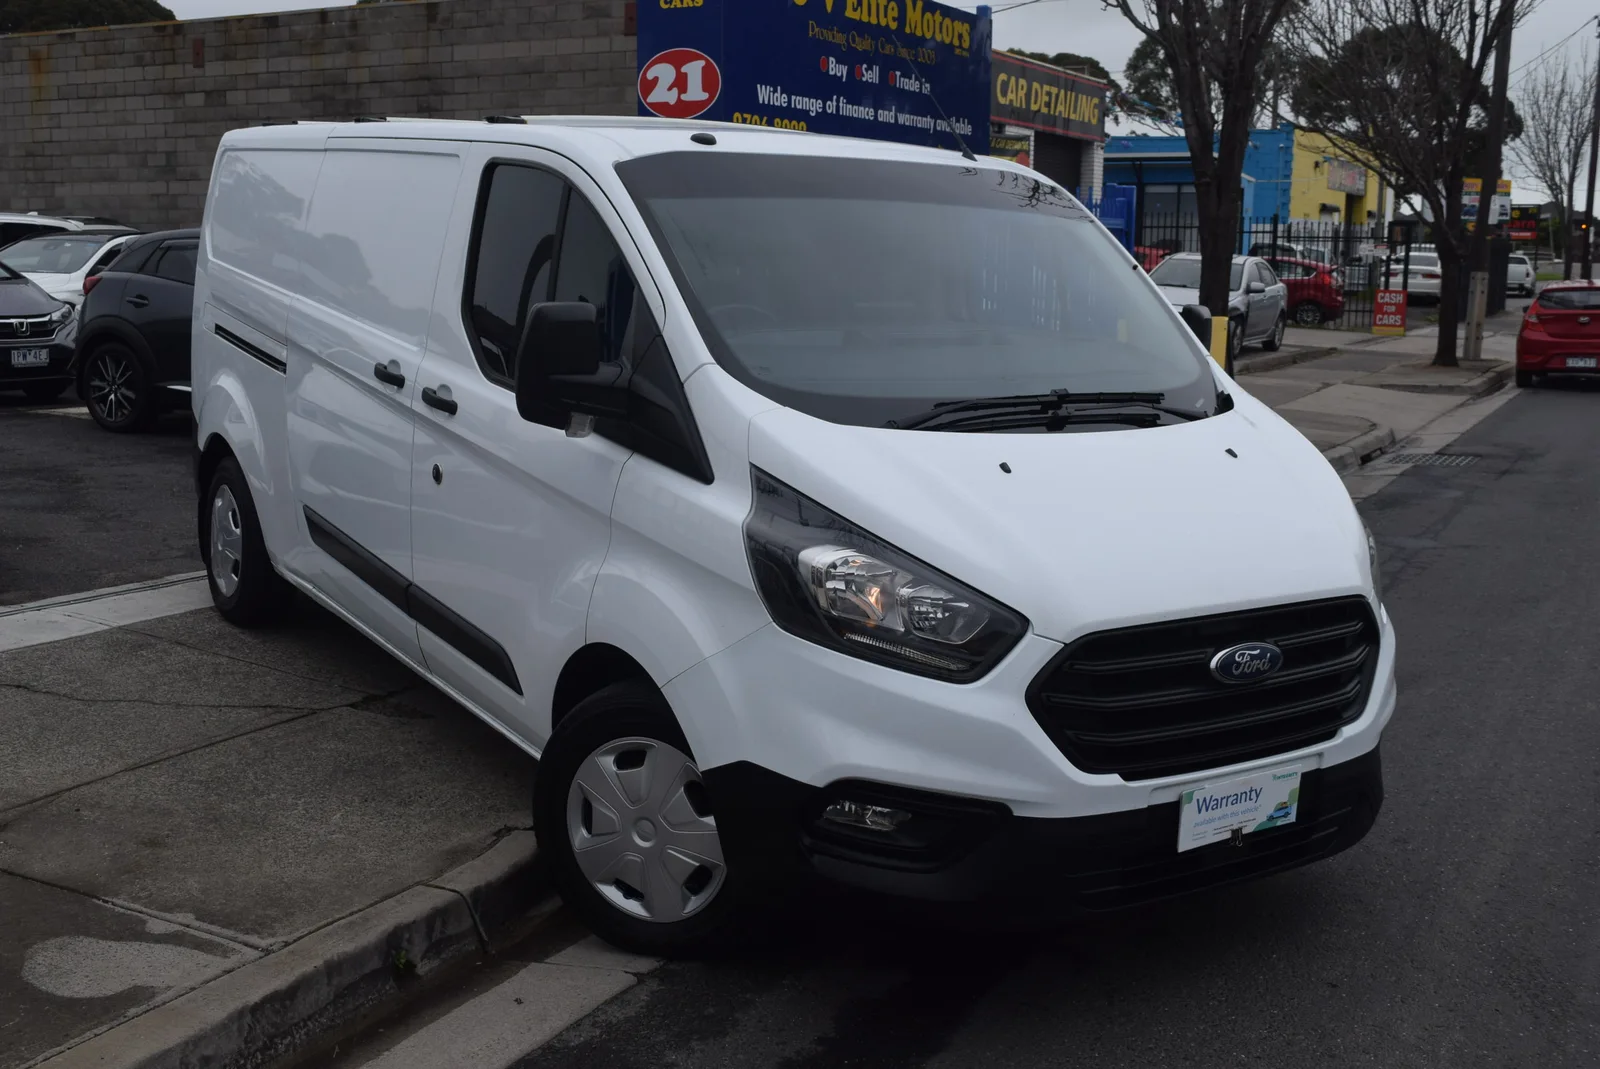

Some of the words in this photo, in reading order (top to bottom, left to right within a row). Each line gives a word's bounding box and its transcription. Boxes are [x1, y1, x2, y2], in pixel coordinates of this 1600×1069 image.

[808, 20, 848, 51] Providing
[845, 0, 898, 30] Elite
[905, 0, 970, 49] Motors
[646, 60, 710, 105] 21
[828, 56, 848, 81] Buy
[862, 63, 880, 84] Sell
[895, 71, 920, 92] Trade
[757, 84, 788, 107] Wide
[791, 95, 823, 116] range
[826, 95, 837, 114] of
[839, 99, 875, 120] finance
[878, 106, 895, 123] and
[897, 113, 935, 133] warranty
[996, 73, 1028, 109] CAR
[1030, 81, 1100, 125] DETAILING
[1377, 292, 1404, 304] CASH
[1383, 305, 1397, 313] FOR
[1376, 314, 1402, 325] CARS
[1232, 649, 1271, 675] Ford
[1196, 786, 1263, 815] Warranty
